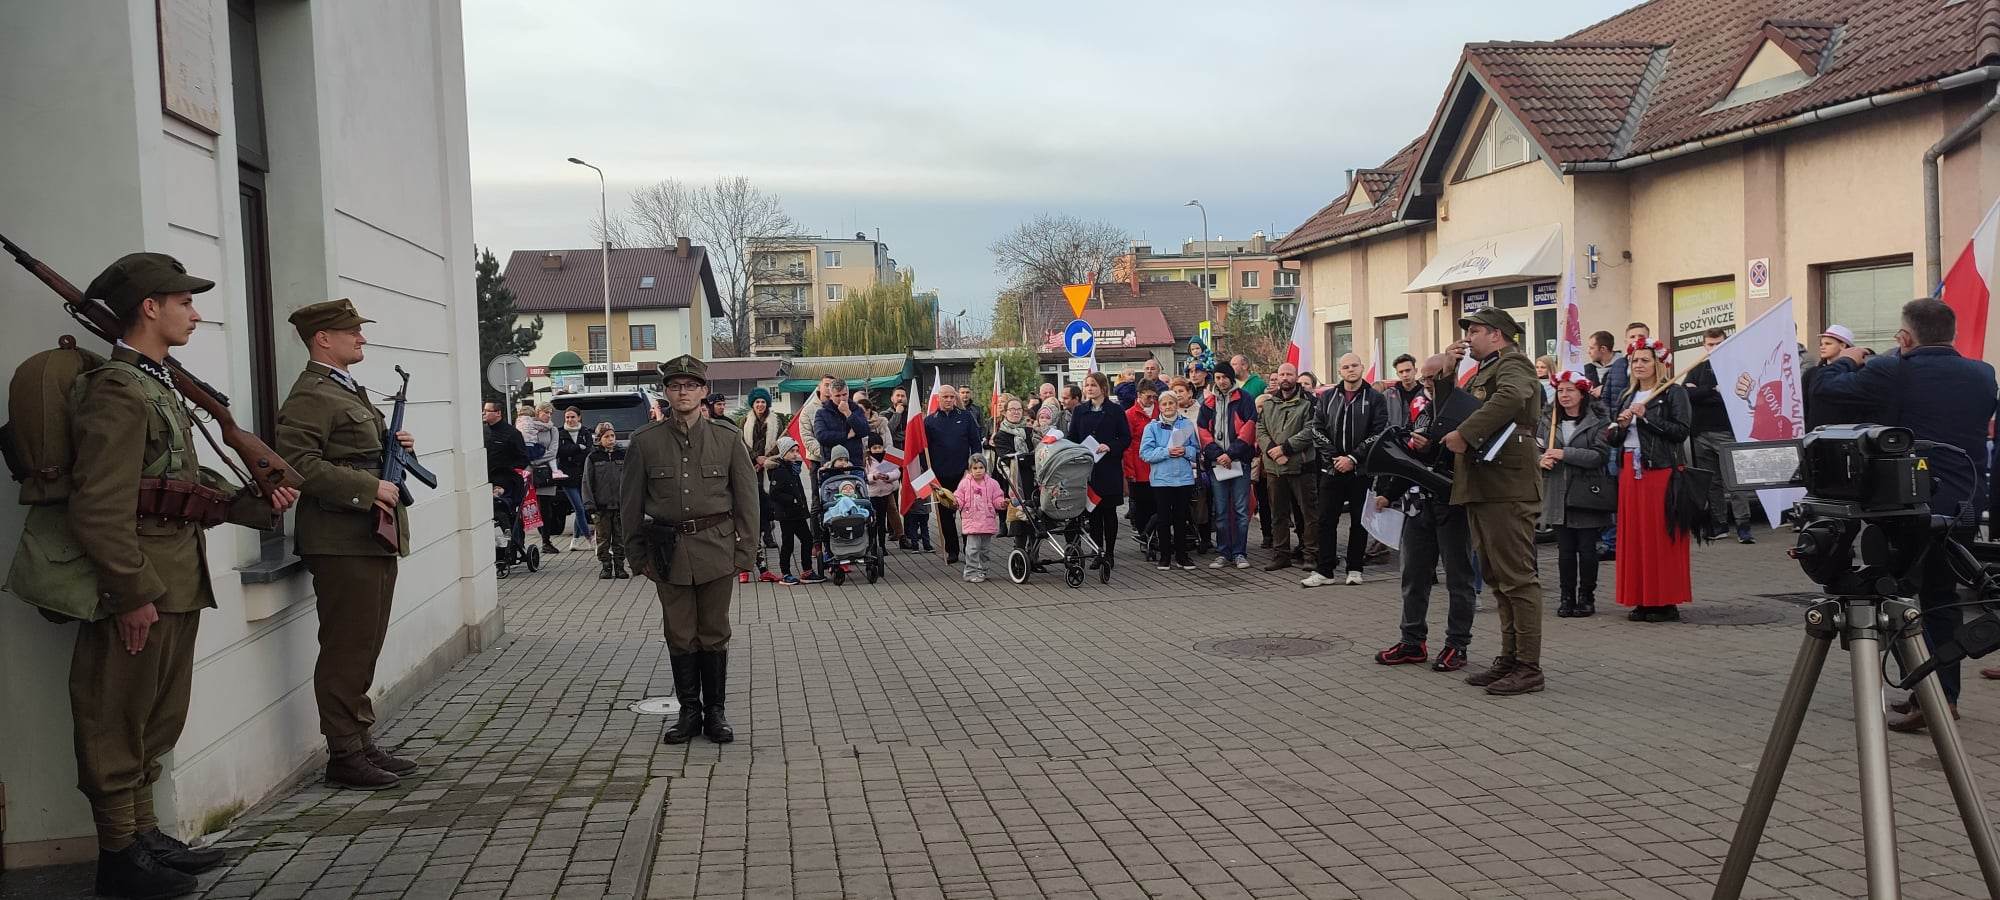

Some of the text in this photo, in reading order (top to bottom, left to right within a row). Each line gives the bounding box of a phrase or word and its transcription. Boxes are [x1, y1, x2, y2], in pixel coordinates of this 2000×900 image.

[1702, 302, 1734, 316] ARTYKUŁY
[1679, 312, 1735, 332] SPOŻYWCZE
[1761, 386, 1782, 417] NOWY
[1917, 459, 1928, 470] A
